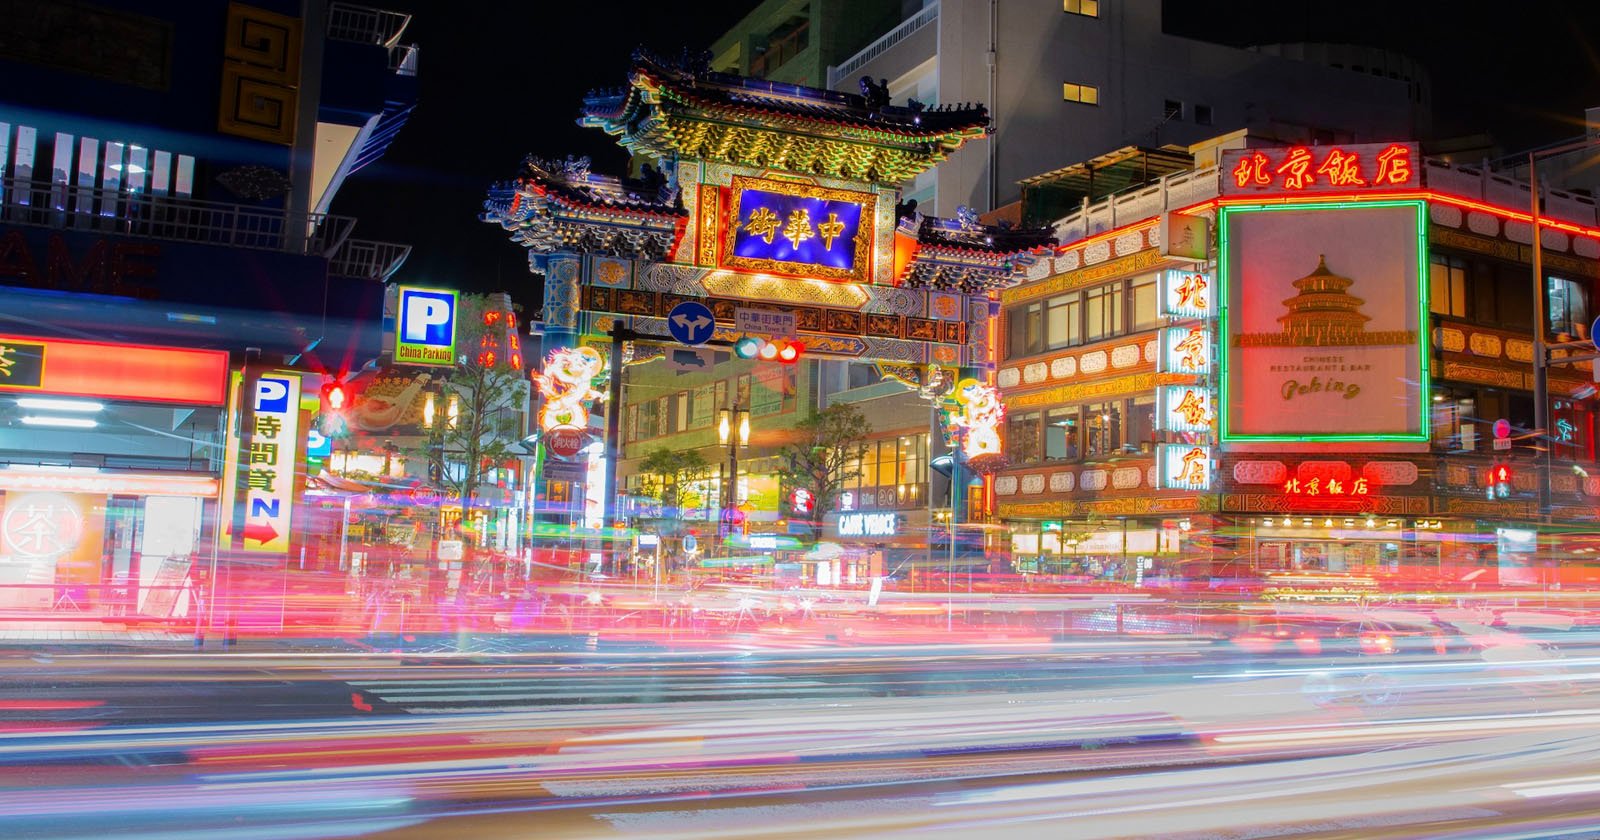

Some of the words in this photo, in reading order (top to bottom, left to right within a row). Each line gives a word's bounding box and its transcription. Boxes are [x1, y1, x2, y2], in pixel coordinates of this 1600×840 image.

[1233, 146, 1410, 189] 北京飯店
[406, 296, 450, 341] P
[739, 312, 793, 327] 中華街東門
[744, 323, 761, 331] China
[400, 346, 421, 358] China
[423, 347, 452, 361] Parking
[1303, 355, 1345, 363] CHINESE
[1270, 364, 1337, 372] RESTAURANT
[1281, 376, 1361, 401] Peking
[553, 438, 579, 449] 消火栓
[1283, 477, 1369, 496] 北京飯店
